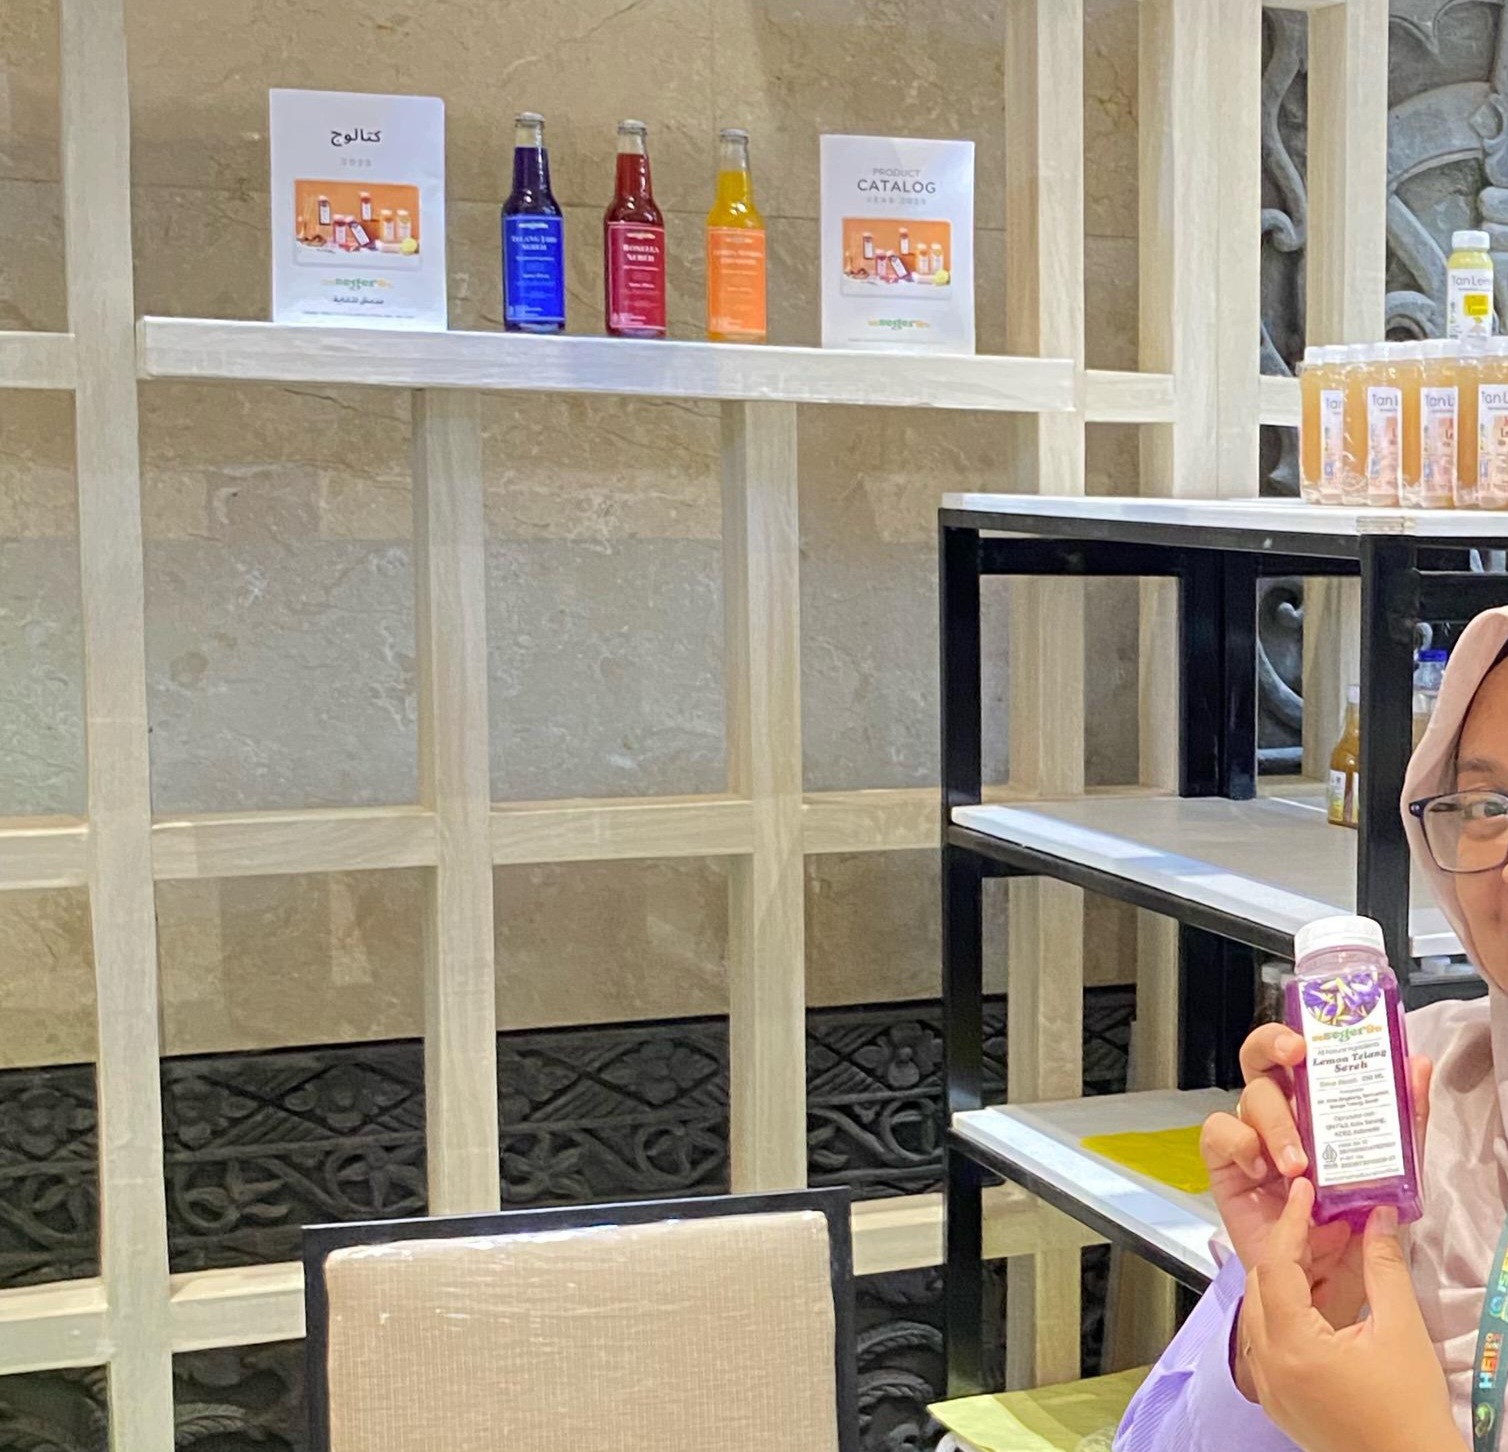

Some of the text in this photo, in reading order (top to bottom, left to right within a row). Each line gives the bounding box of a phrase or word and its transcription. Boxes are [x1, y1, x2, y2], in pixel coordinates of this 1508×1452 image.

[331, 128, 383, 147] كتالوج
[872, 168, 921, 178] PRODUCT
[857, 179, 938, 194] CATALOG
[1312, 1049, 1387, 1067] Lemon Telang
[1334, 1061, 1369, 1073] Sereh
